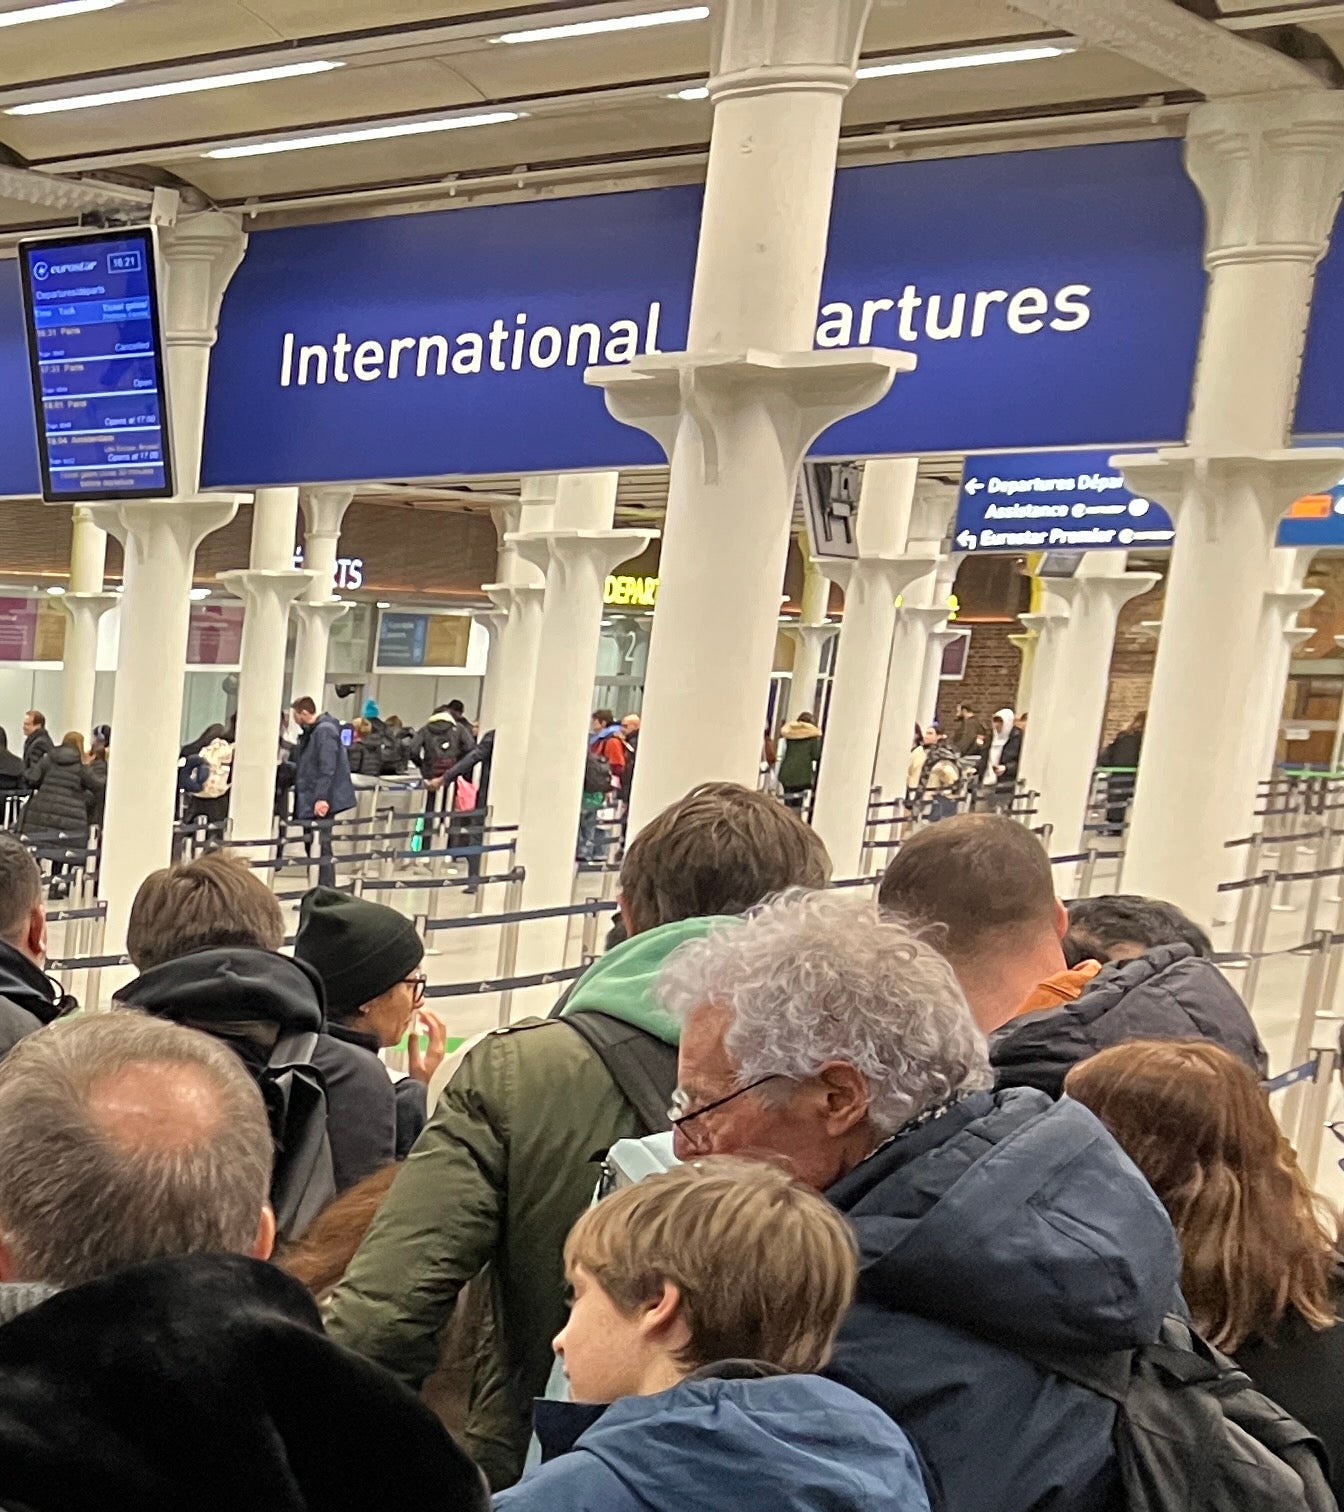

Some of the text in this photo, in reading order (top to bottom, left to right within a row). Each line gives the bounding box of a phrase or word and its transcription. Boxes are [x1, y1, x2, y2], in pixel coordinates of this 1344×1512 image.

[280, 284, 1092, 387] International artures
[984, 503, 1069, 519] Assistance
[624, 630, 637, 662] 2
